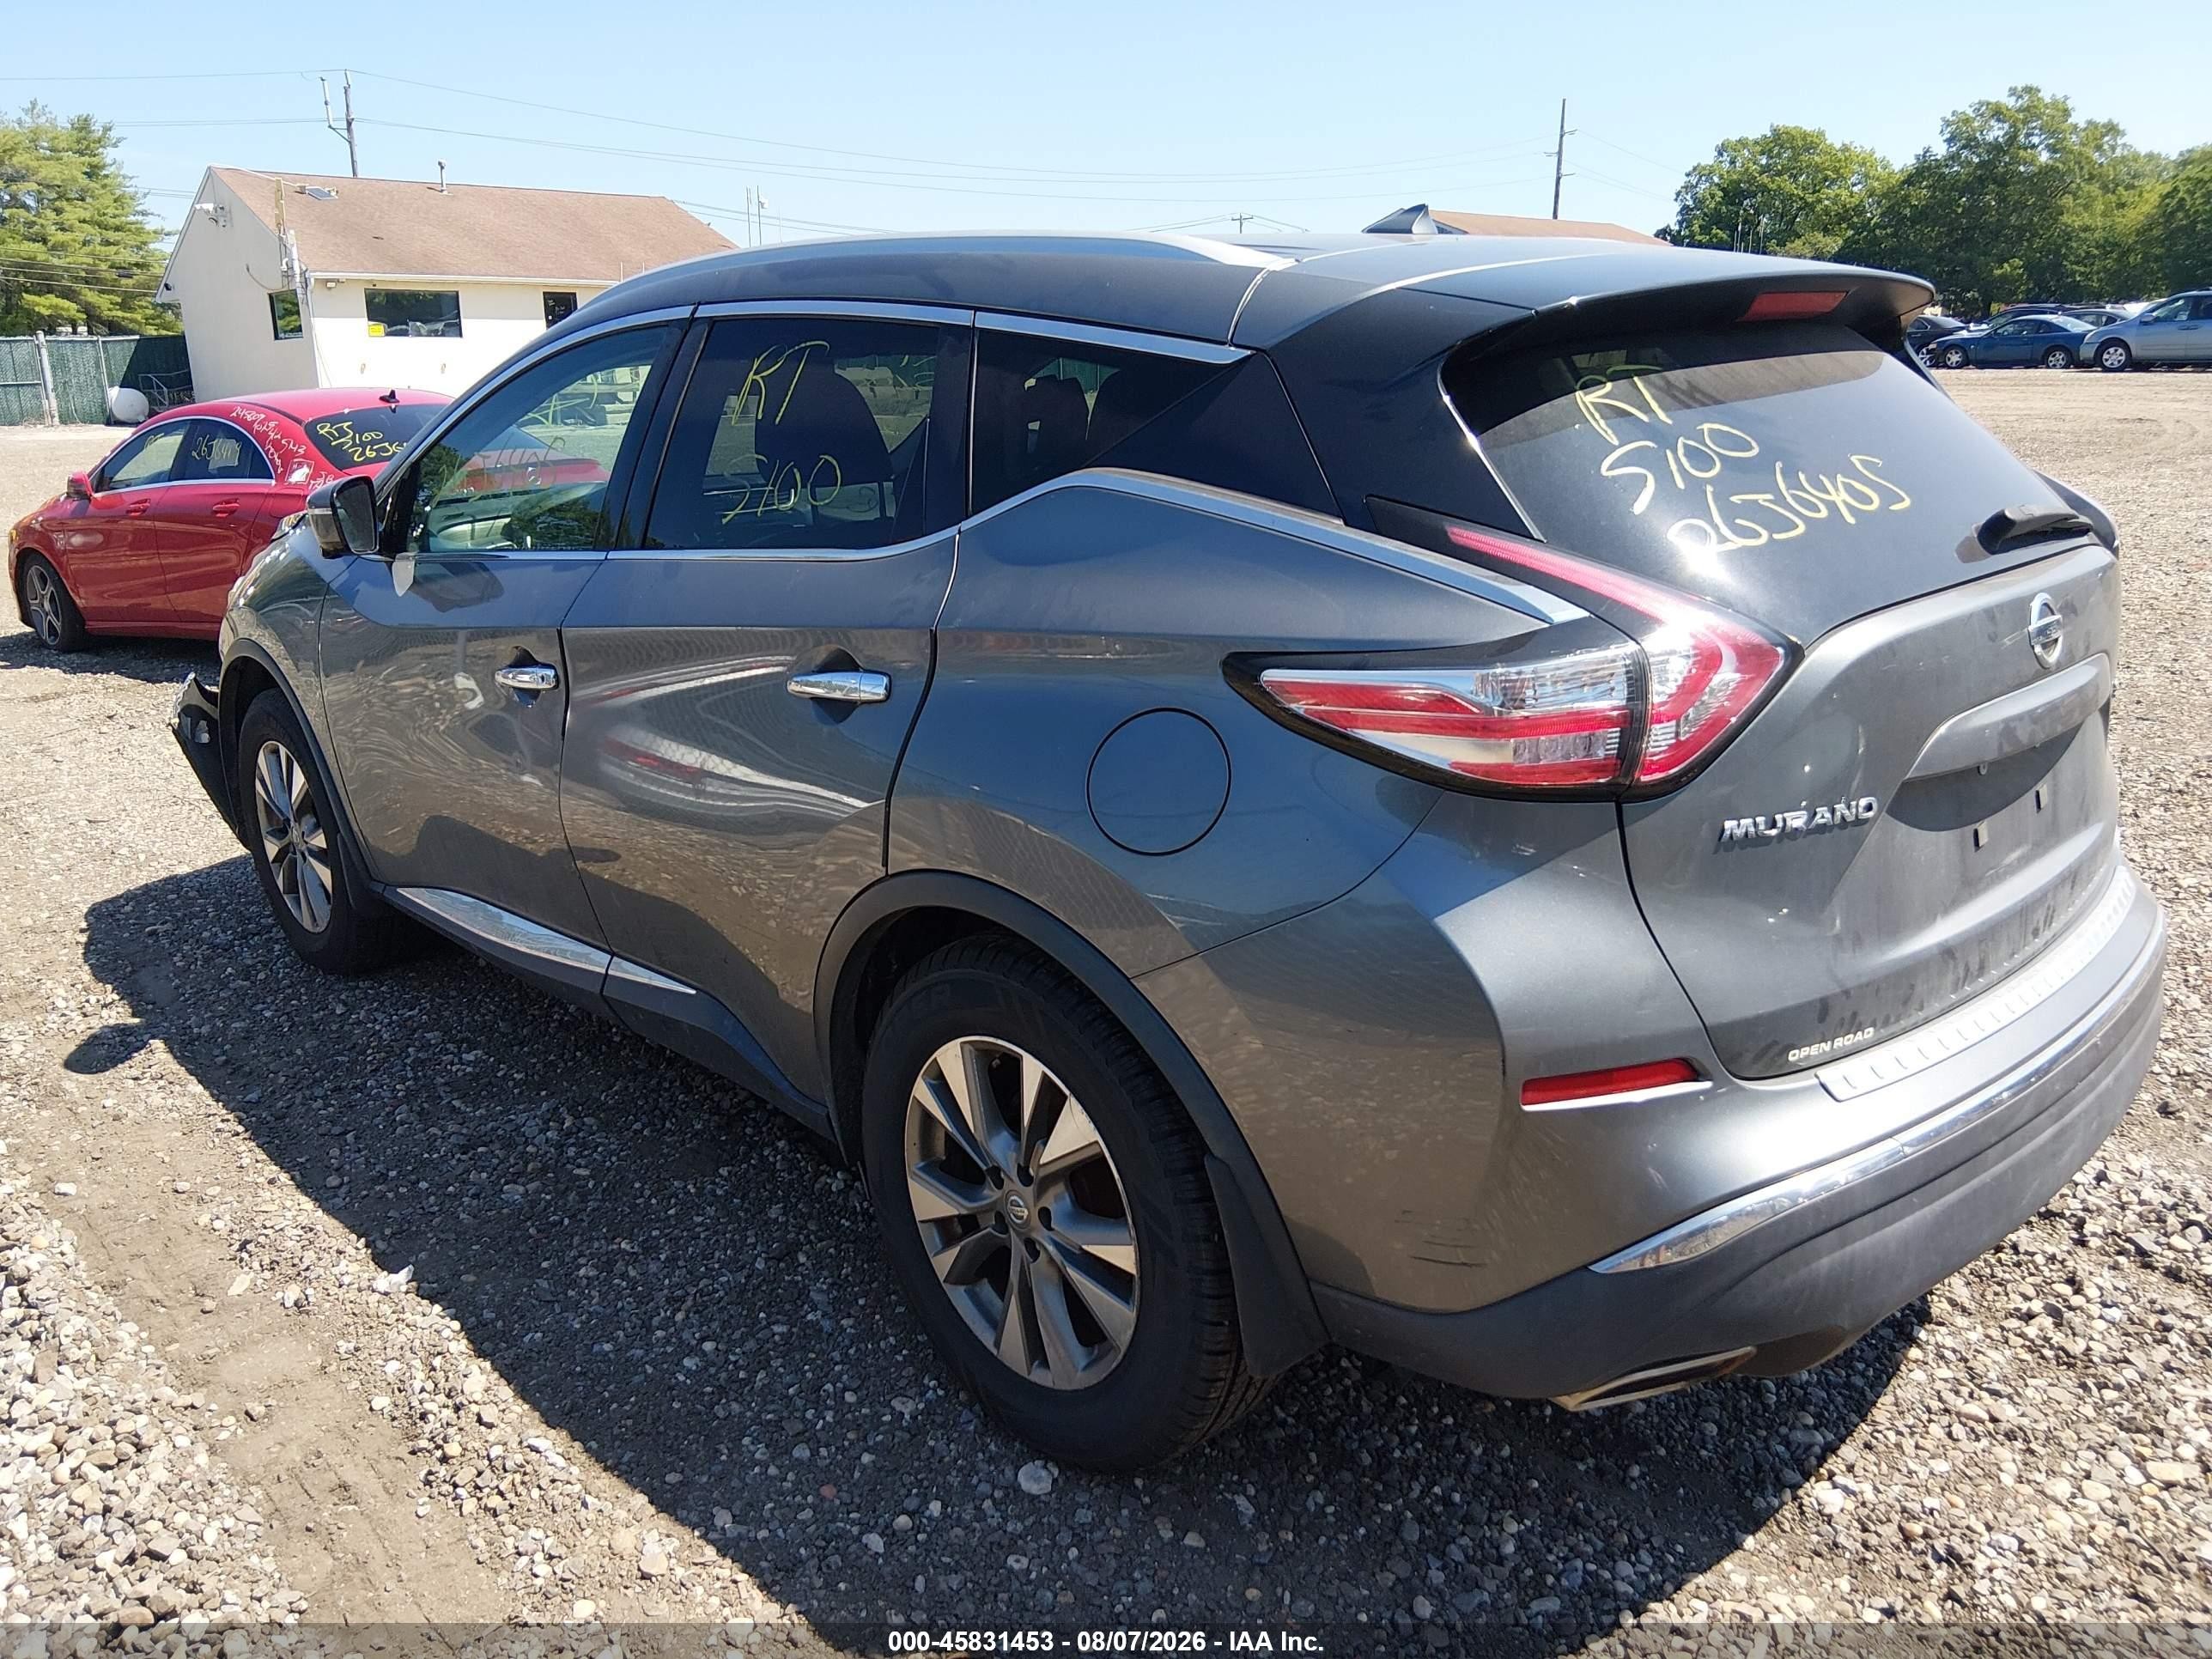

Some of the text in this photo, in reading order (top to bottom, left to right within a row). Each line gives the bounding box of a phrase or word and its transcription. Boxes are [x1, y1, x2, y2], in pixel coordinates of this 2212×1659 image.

[1601, 422, 1760, 514] 5100
[1720, 796, 1878, 843] MURANO
[1788, 1026, 1875, 1062] OPEN ROAD
